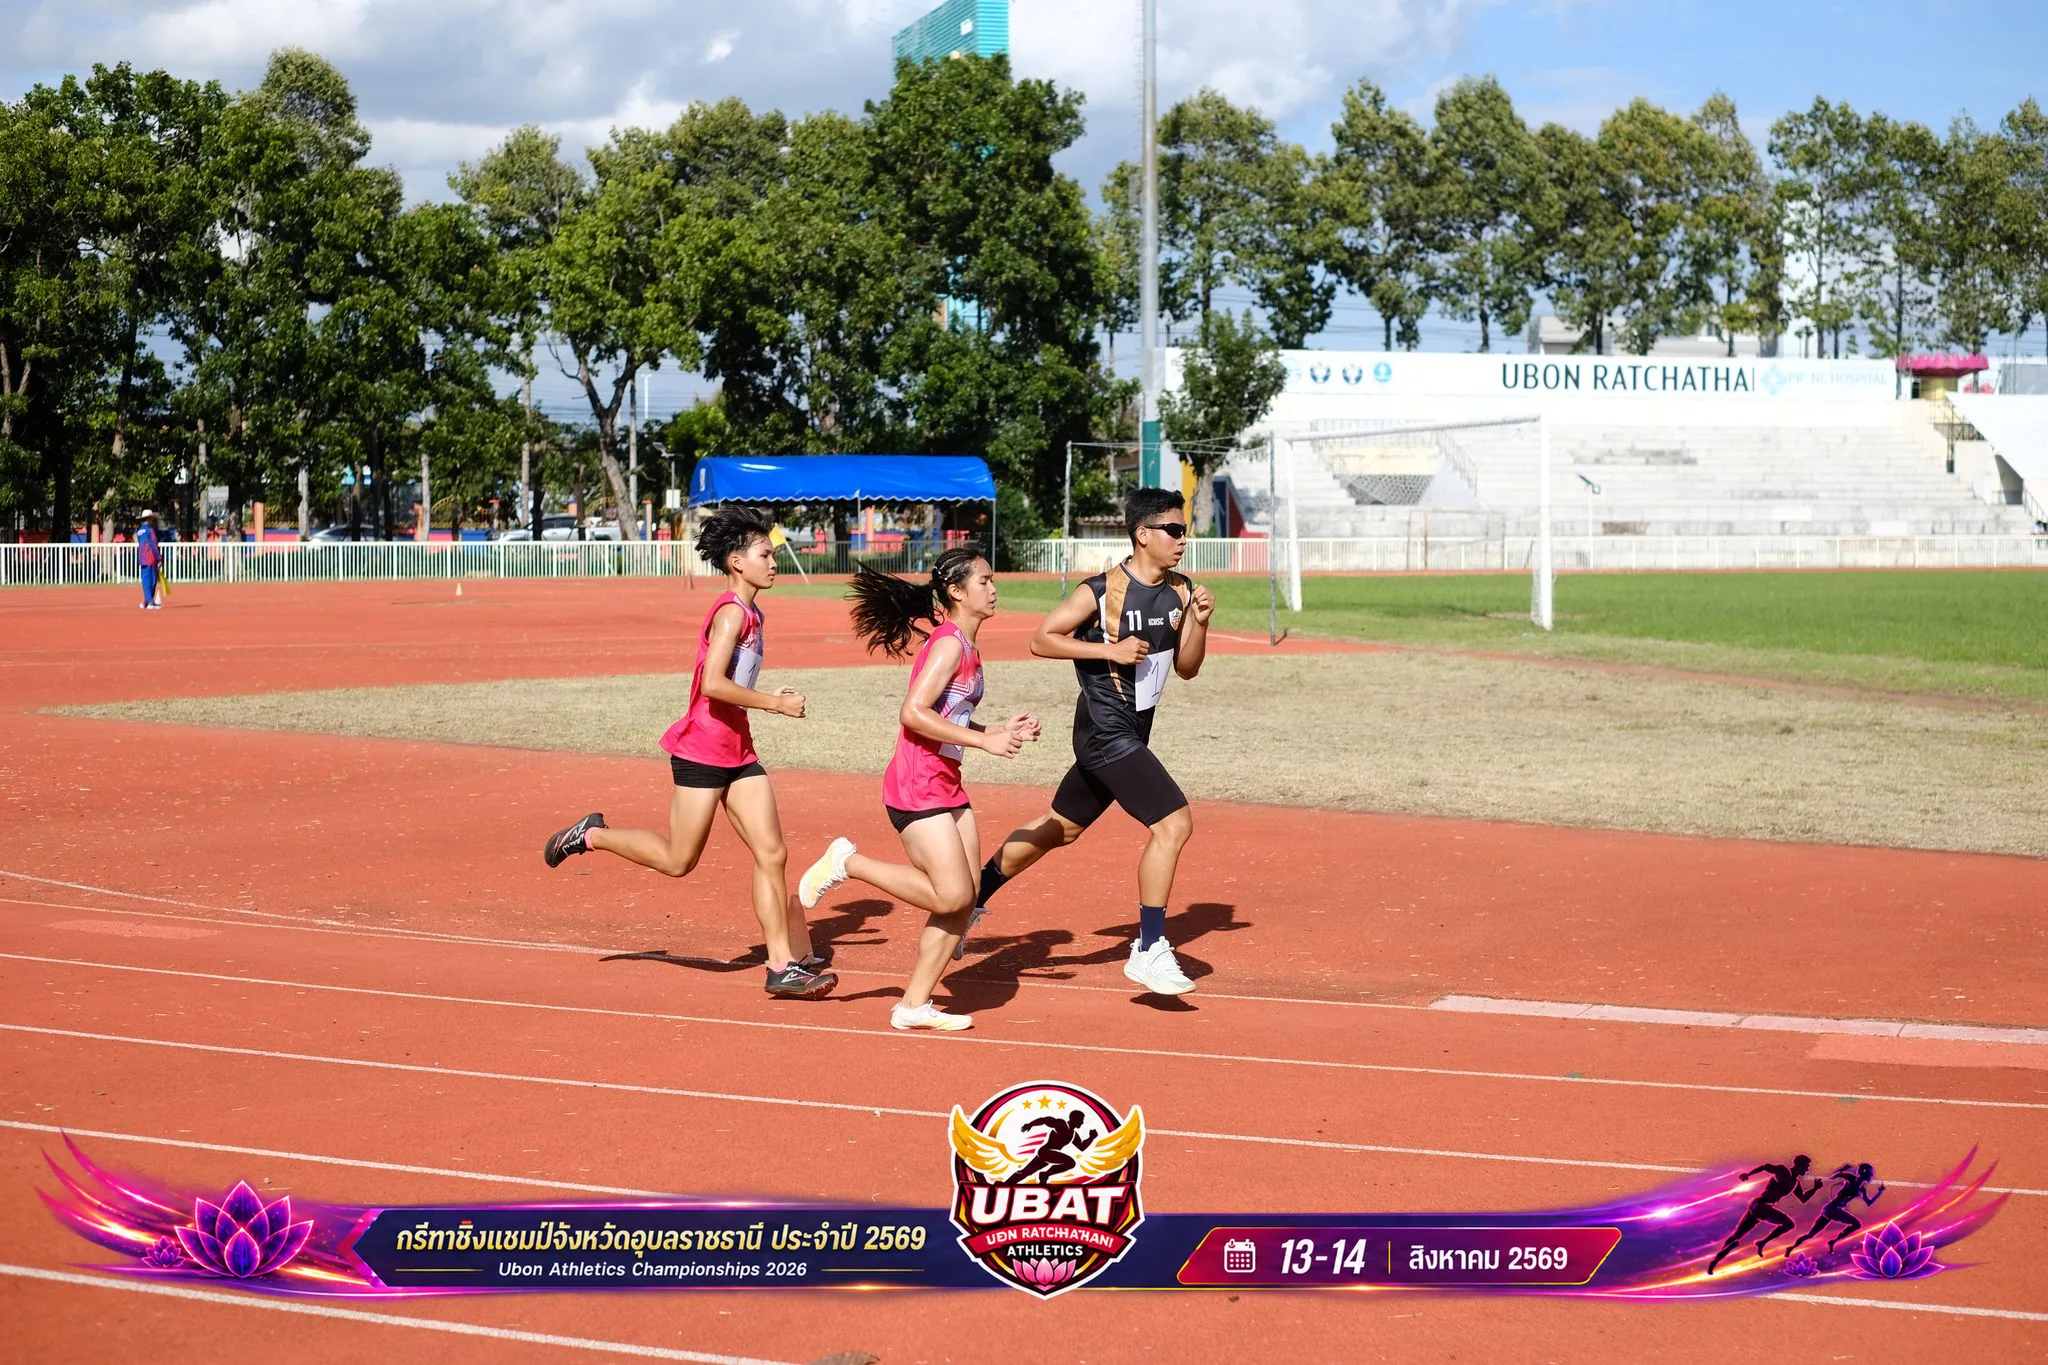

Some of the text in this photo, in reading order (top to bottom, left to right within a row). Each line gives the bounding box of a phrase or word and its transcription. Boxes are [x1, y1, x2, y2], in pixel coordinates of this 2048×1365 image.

[1501, 363, 1581, 390] UBON
[1830, 371, 1889, 385] HOSPITAL
[1126, 610, 1142, 632] 11
[1151, 660, 1160, 698] 1
